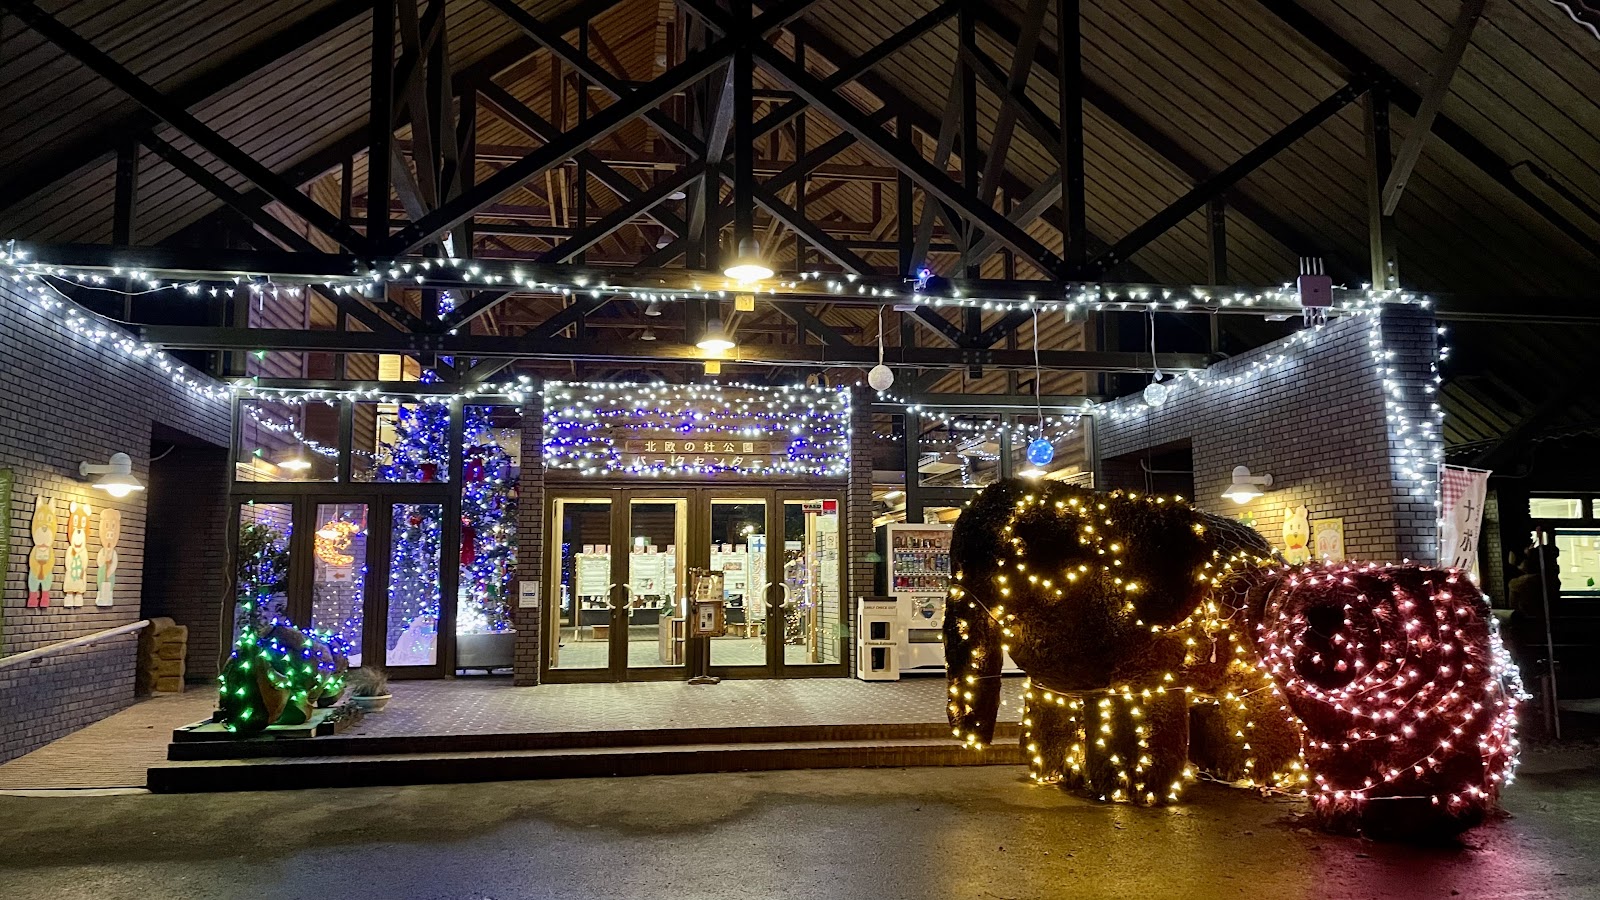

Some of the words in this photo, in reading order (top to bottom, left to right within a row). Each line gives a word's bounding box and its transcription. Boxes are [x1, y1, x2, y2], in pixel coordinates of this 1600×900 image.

[644, 441, 754, 453] 北欧の杜公園
[635, 455, 764, 467] パークセンター
